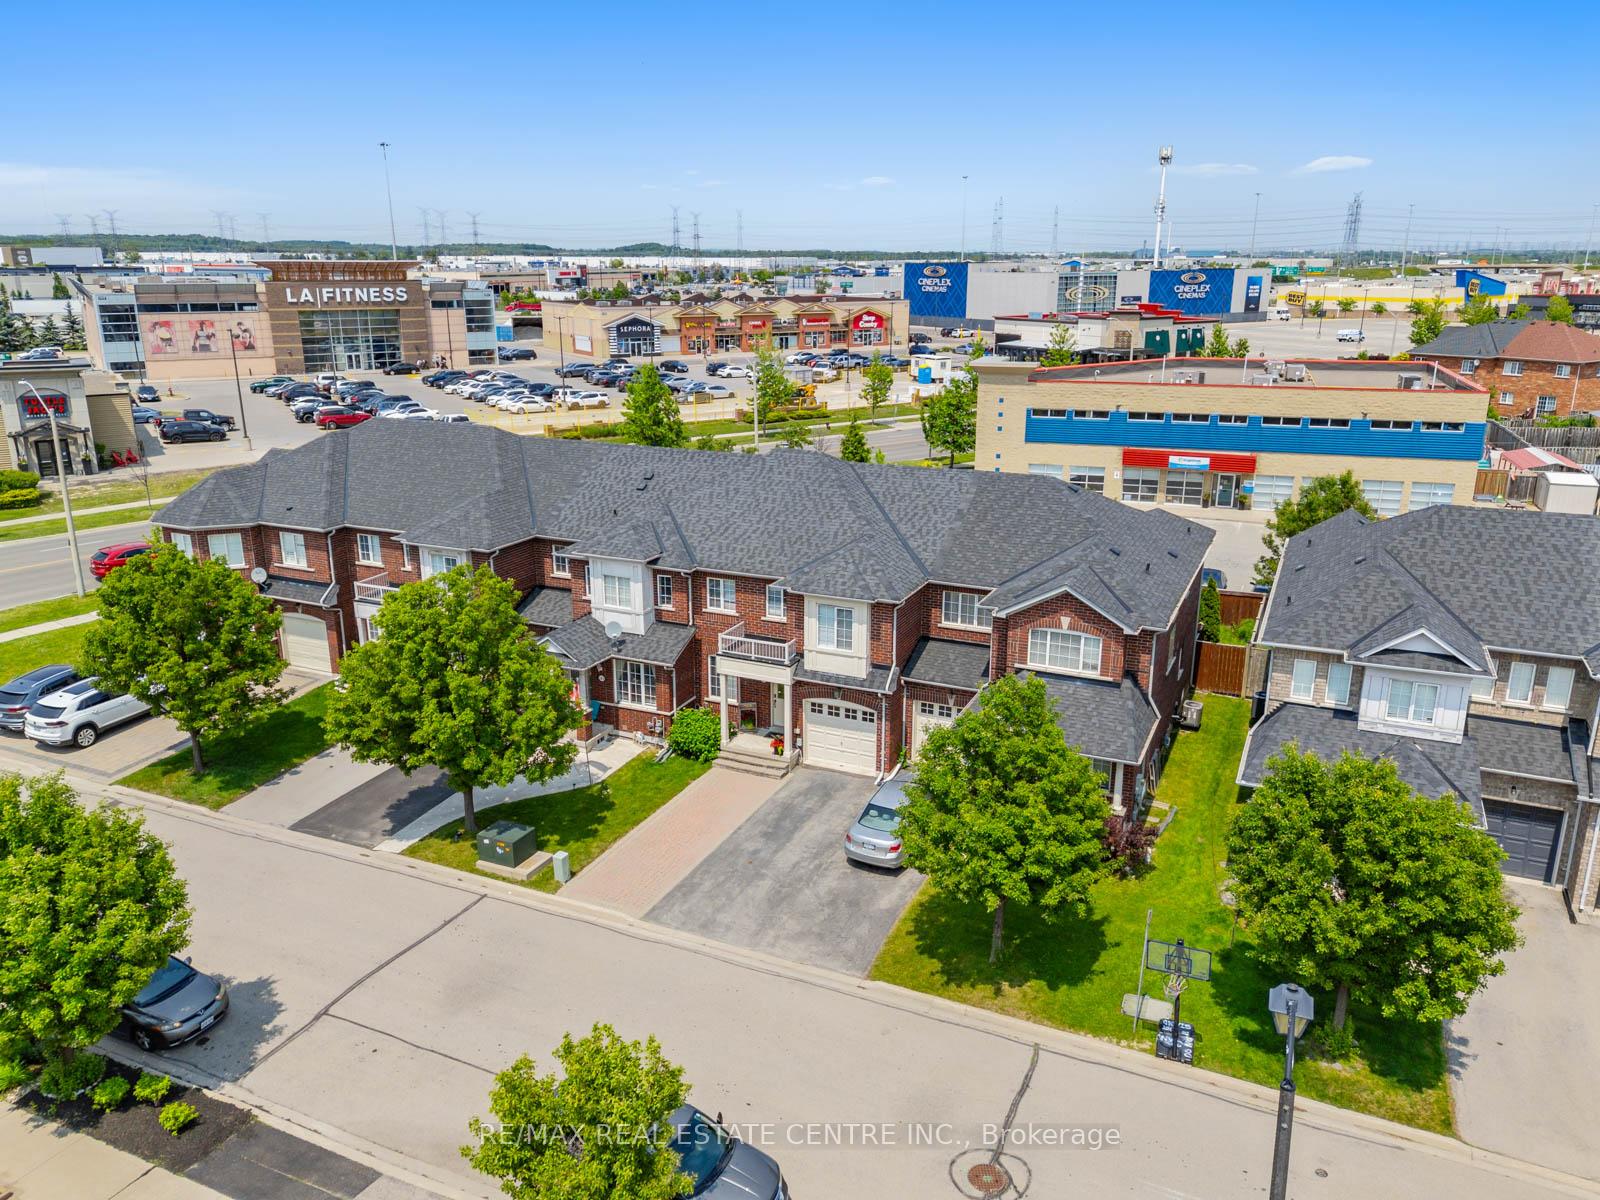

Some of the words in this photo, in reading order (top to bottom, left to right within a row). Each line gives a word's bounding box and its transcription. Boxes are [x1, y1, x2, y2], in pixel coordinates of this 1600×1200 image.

[917, 278, 951, 286] CINEPLEX
[1470, 281, 1480, 289] BEST
[1174, 284, 1211, 293] CINEPLEX
[285, 287, 315, 302] LA
[321, 287, 408, 302] FITNESS
